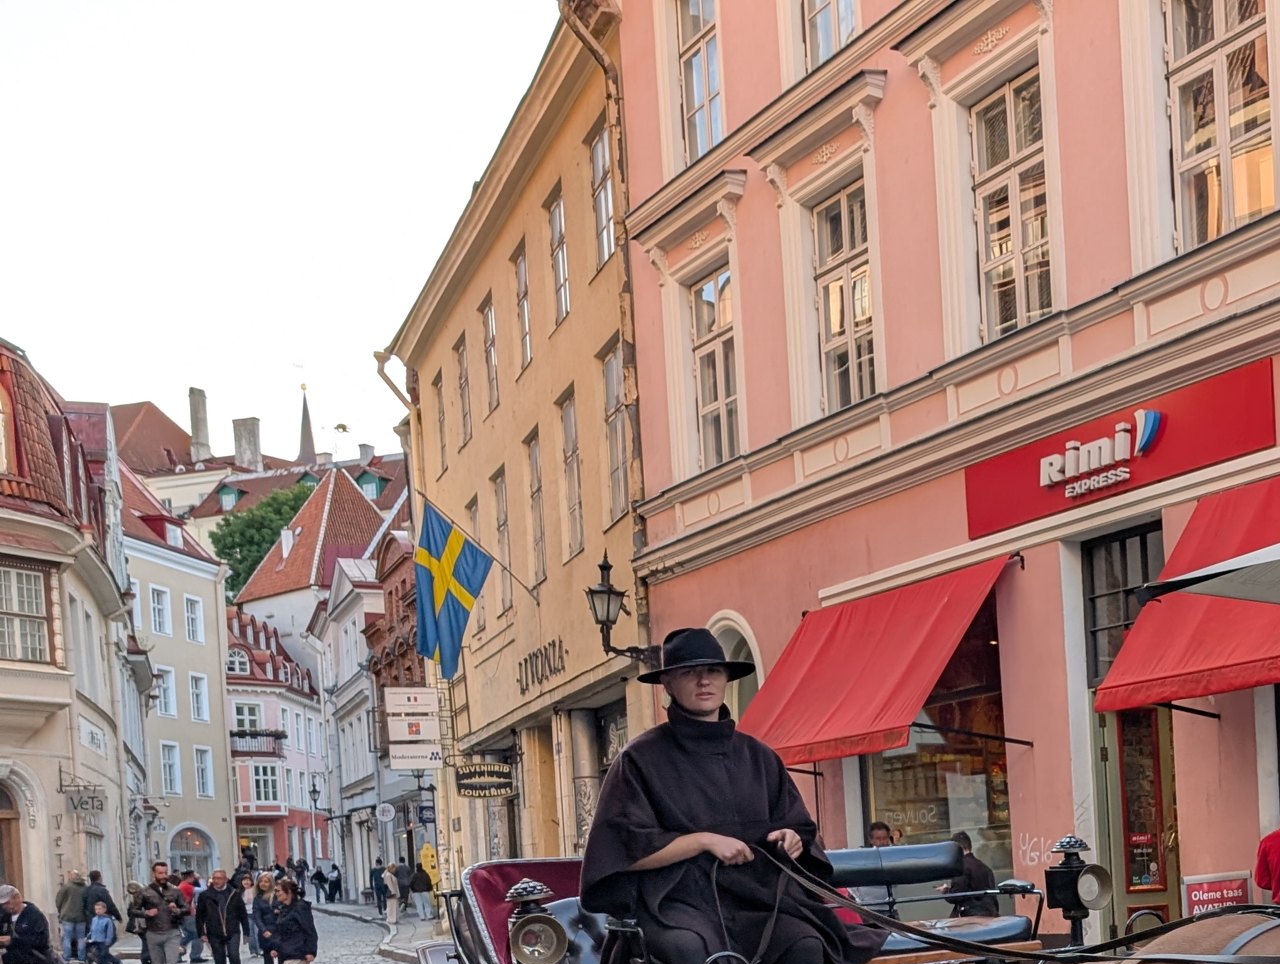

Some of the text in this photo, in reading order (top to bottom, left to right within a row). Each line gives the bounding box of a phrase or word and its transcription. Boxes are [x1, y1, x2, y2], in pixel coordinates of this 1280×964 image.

[1040, 421, 1132, 487] Rimi
[1065, 466, 1131, 498] EXPRESS
[457, 763, 510, 775] SUVENIIRID
[460, 787, 512, 797] SOUVENIRS
[1191, 888, 1243, 901] Oleme taas
